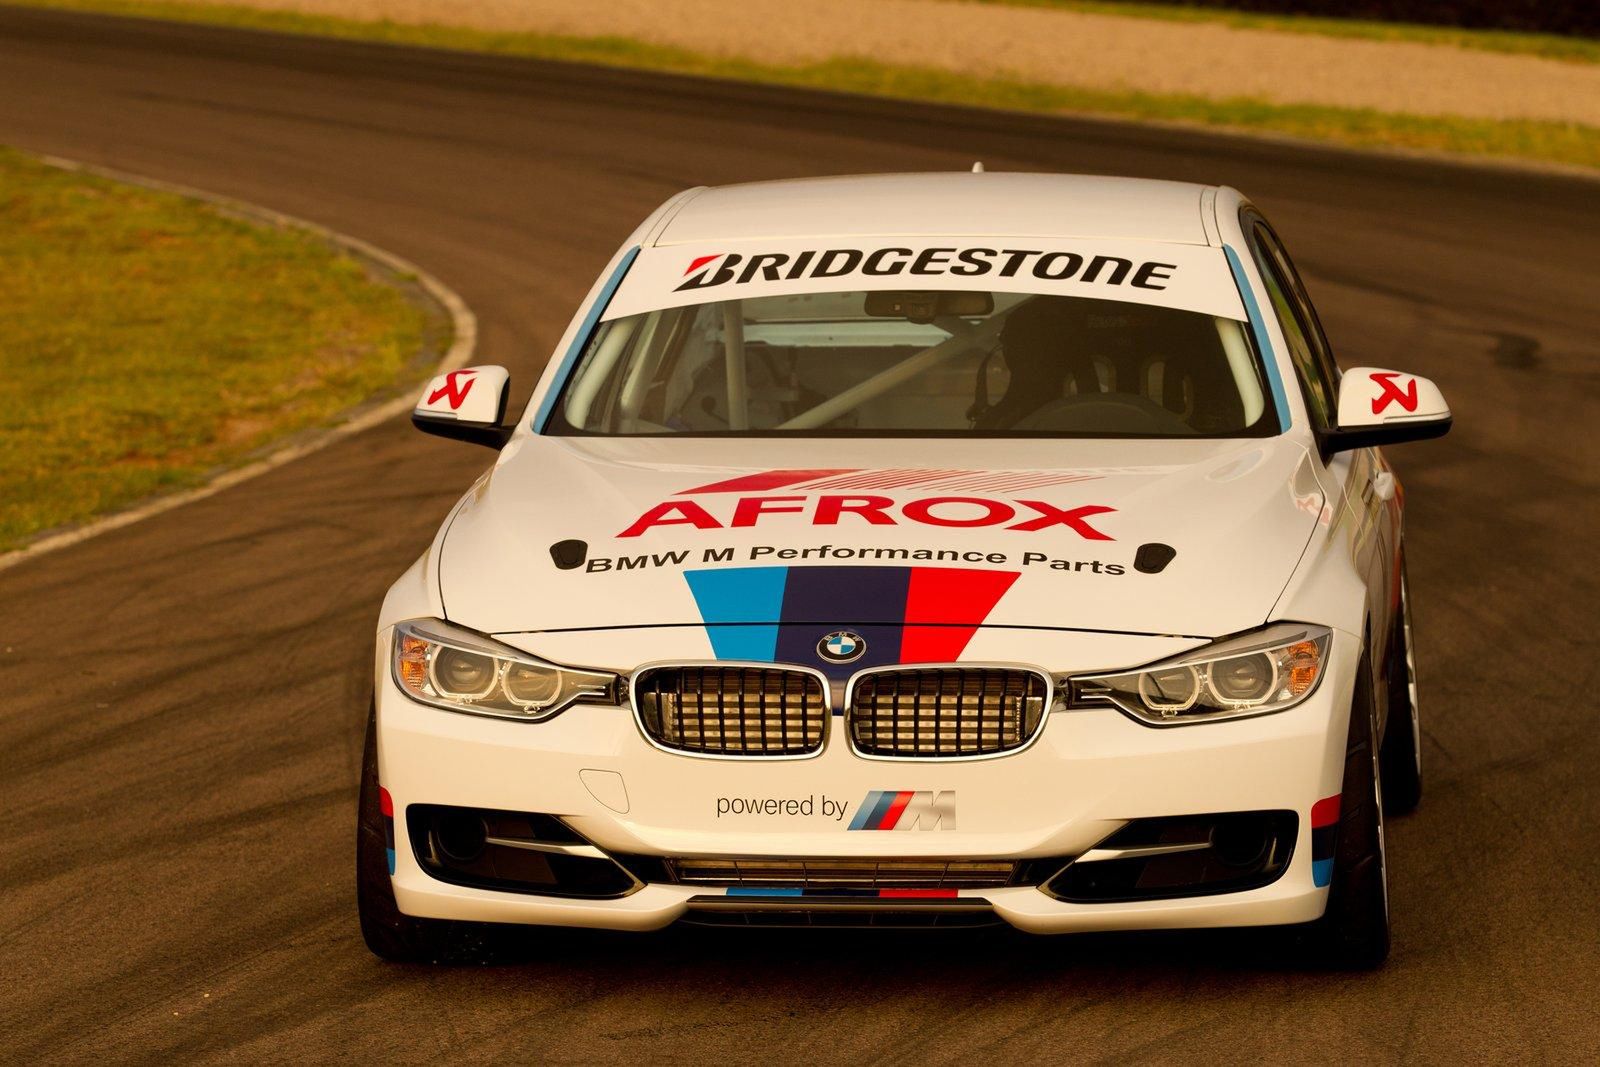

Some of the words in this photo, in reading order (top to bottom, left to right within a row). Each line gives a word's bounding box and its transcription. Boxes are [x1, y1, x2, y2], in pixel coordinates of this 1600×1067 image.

[673, 247, 1177, 292] BRIDGESTONE
[615, 494, 1117, 541] AFROX
[585, 550, 690, 574] BMW
[702, 547, 735, 563] M
[749, 544, 1007, 564] Performance
[1022, 551, 1126, 577] Parts
[824, 631, 862, 642] BMW
[717, 794, 814, 818] powered
[822, 794, 849, 822] by
